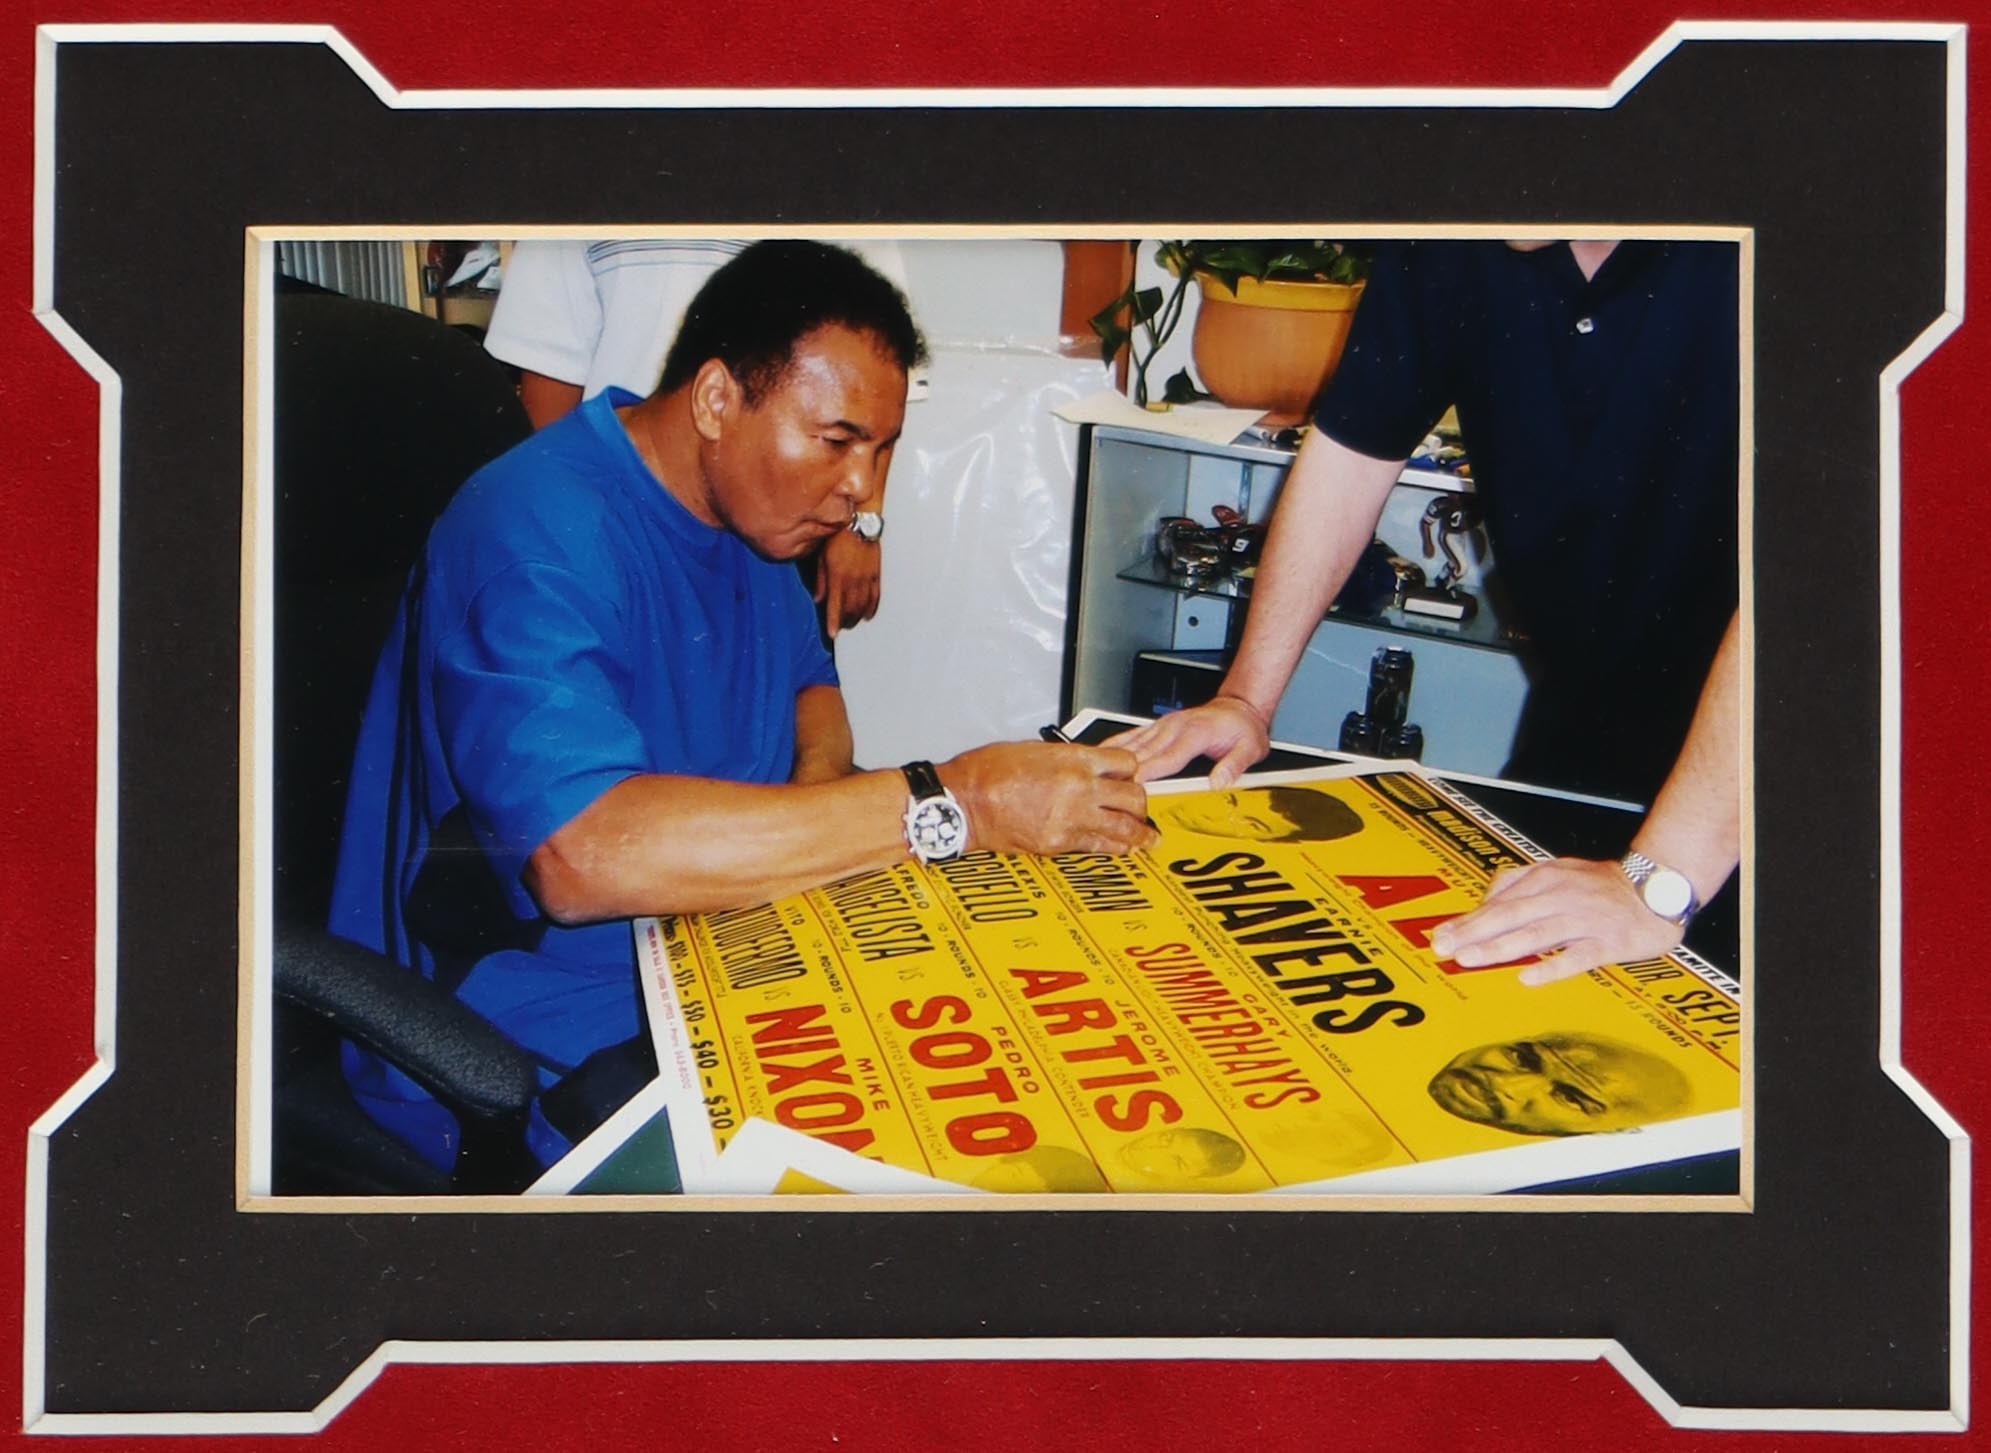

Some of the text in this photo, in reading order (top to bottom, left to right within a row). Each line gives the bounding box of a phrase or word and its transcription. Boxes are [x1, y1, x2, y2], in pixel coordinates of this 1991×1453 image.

[1424, 807, 1502, 859] madison
[933, 850, 1038, 923] RGUELLO
[1004, 854, 1046, 898] ALEXIS
[1051, 851, 1153, 912] SSMAN
[785, 907, 805, 926] VITO
[822, 868, 934, 962] ANGELISTA
[1157, 851, 1425, 1034] SHAVERS
[1315, 898, 1383, 956] EARNIE
[1336, 875, 1541, 975] AL
[820, 955, 843, 992] ROUNDS
[948, 940, 975, 978] ROUNDS
[1672, 946, 1723, 982] AMITE
[1115, 1000, 1180, 1076] JEROME
[1124, 943, 1321, 1109] SUMMERHAYS
[1242, 994, 1290, 1037] GARY
[1642, 1012, 1694, 1049] ROUNDS
[690, 1040, 719, 1069] $40
[890, 995, 1038, 1157] SOTO
[991, 1026, 1040, 1094] PEDRO
[1008, 968, 1184, 1132] ARTIS
[701, 1095, 734, 1130] $30
[856, 1058, 891, 1112] MIKE
